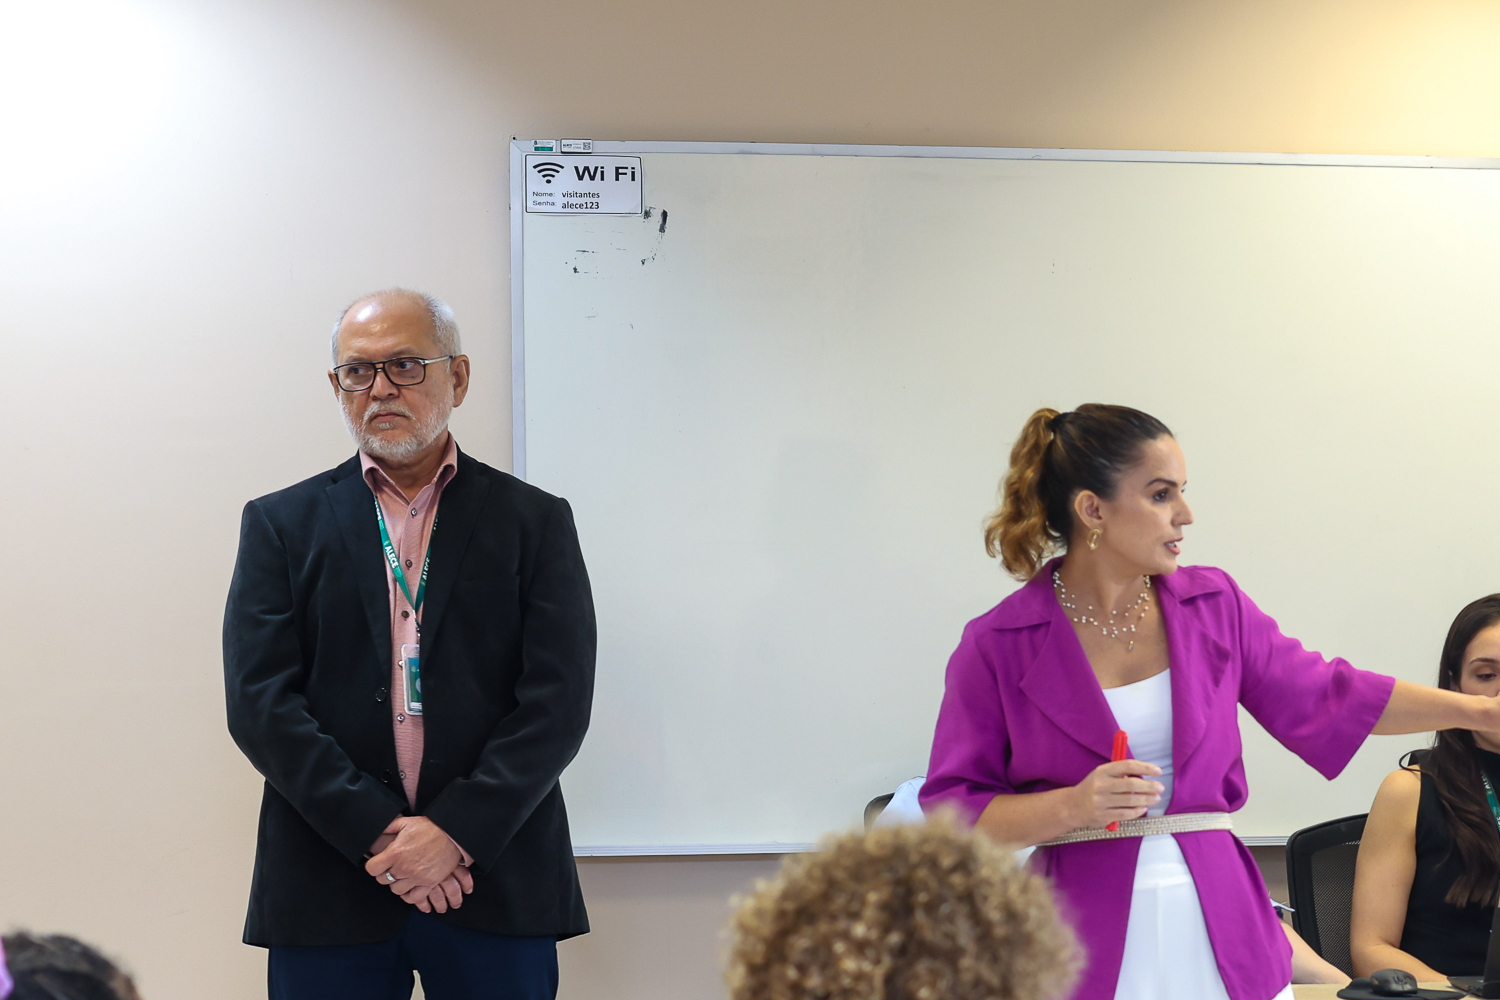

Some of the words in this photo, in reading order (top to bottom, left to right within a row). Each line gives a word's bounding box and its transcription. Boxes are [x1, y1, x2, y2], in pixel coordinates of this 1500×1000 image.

[573, 165, 605, 182] Wi
[614, 166, 636, 182] Fi
[561, 190, 601, 199] visitantes
[561, 201, 600, 210] alece123
[385, 545, 398, 568] ALECE
